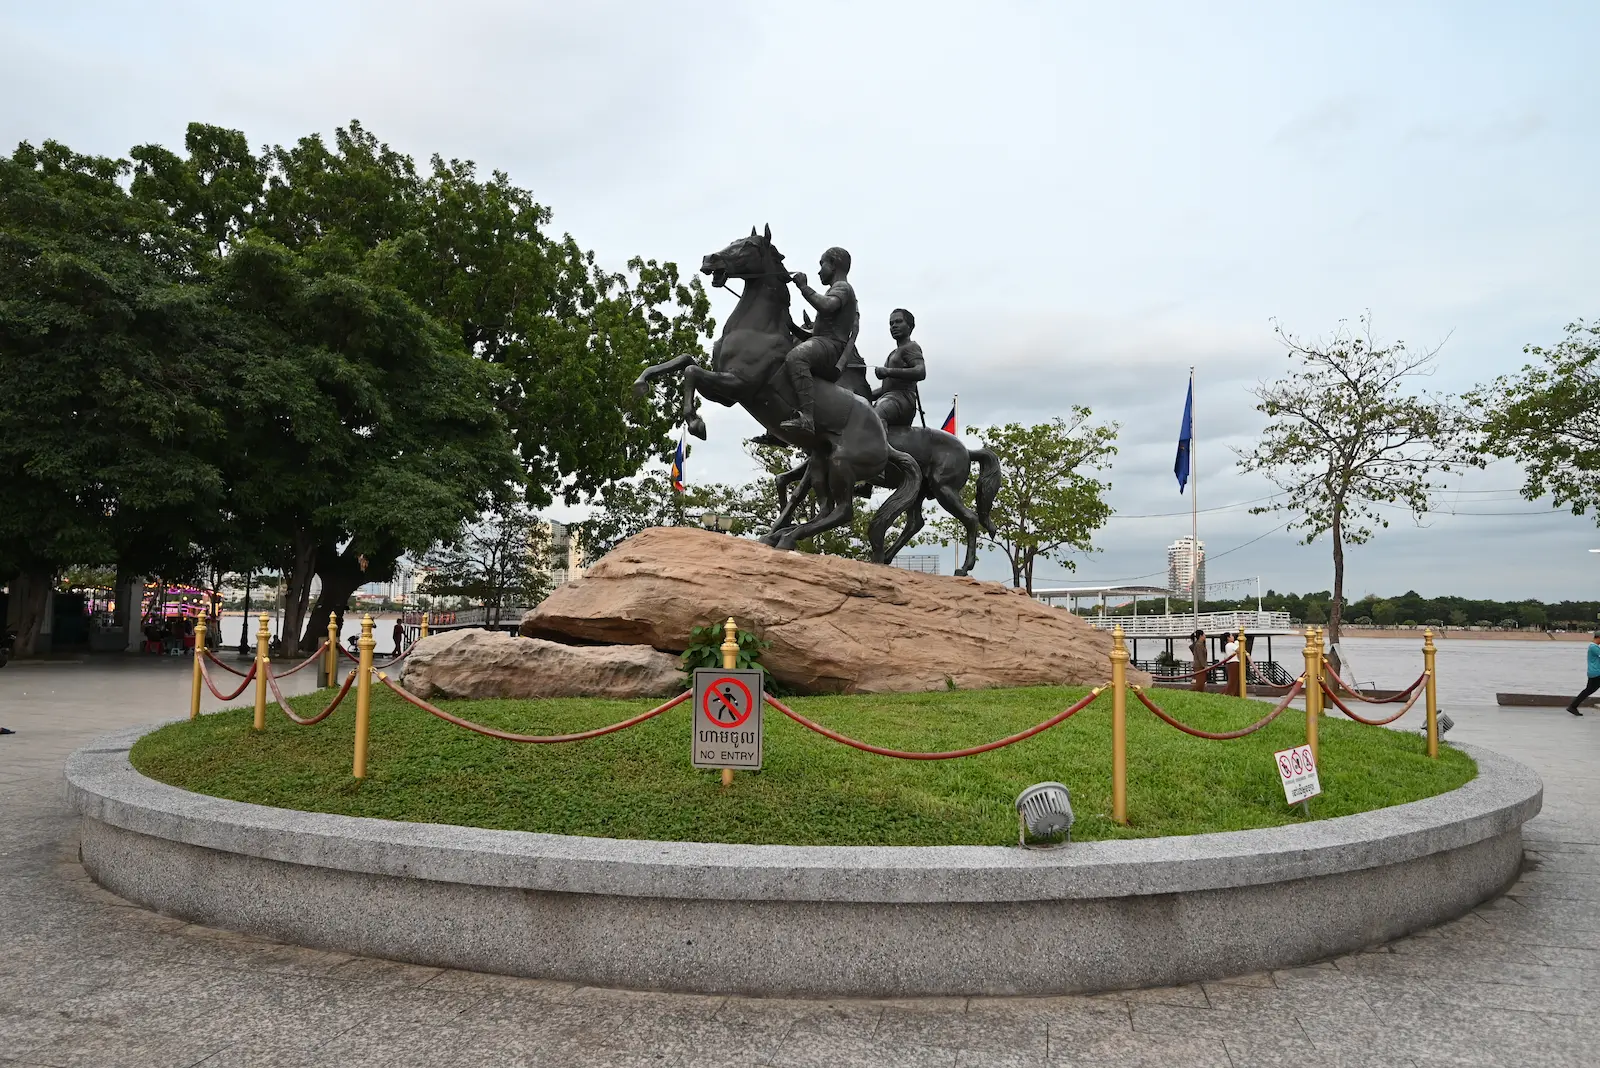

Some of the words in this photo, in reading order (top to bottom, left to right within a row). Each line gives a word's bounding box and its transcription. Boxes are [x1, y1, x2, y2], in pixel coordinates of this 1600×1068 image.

[699, 730, 755, 749] ហាមចូល
[700, 750, 715, 760] NO
[721, 751, 755, 761] ENTRY
